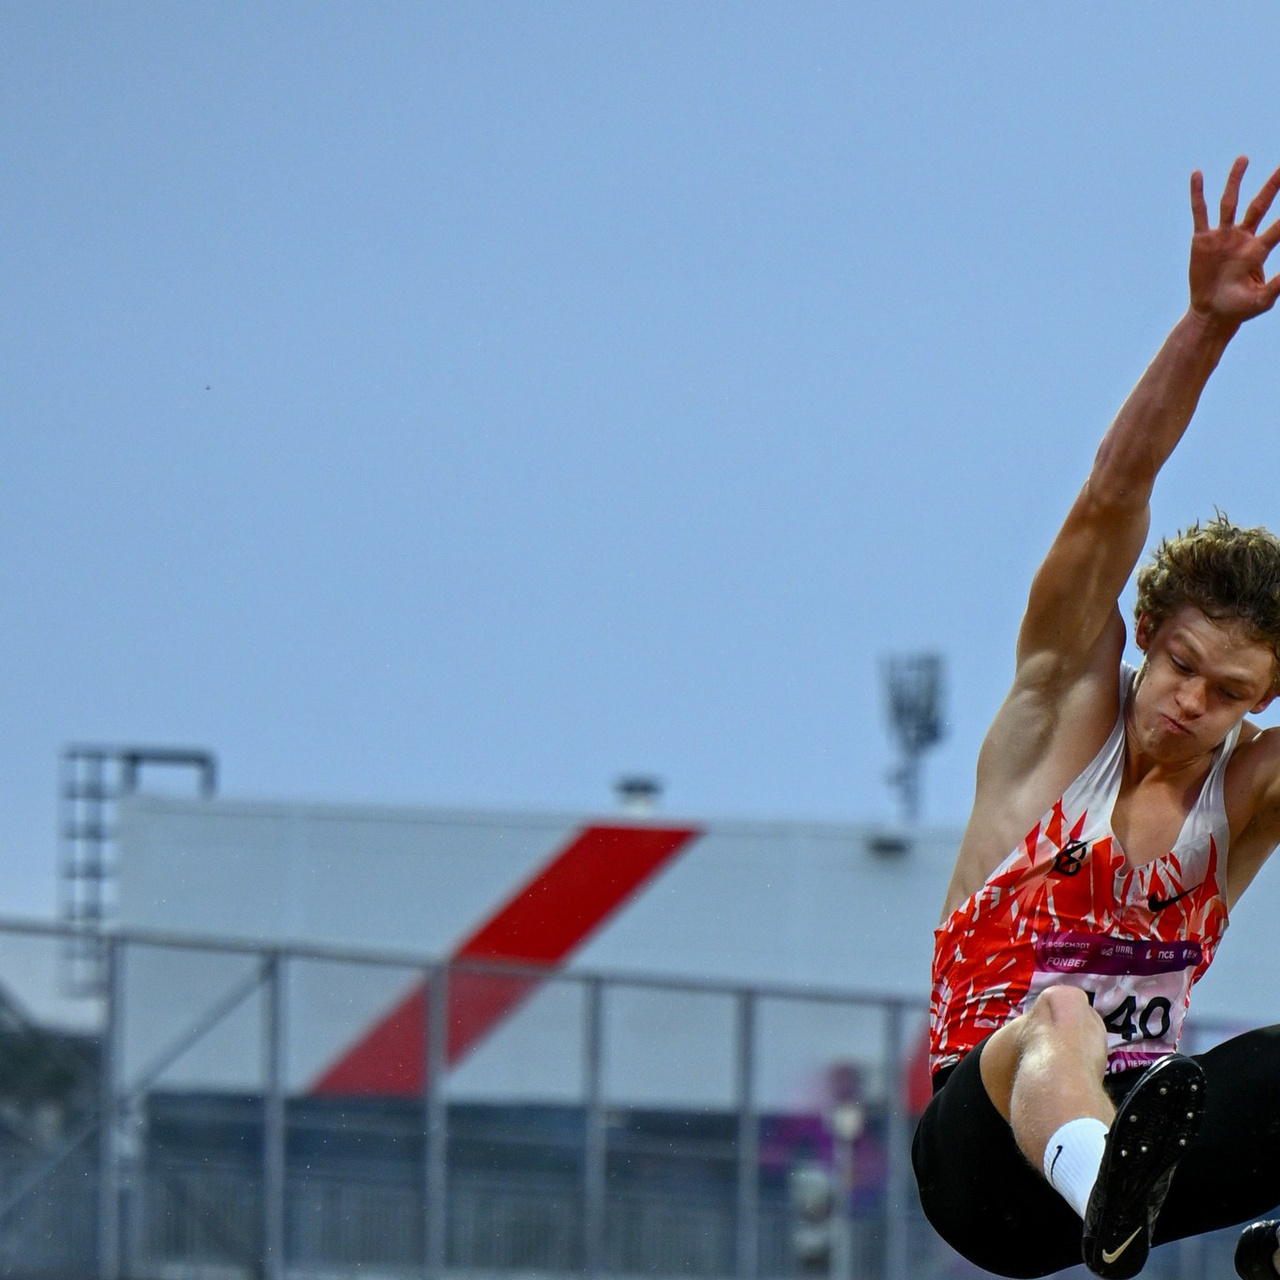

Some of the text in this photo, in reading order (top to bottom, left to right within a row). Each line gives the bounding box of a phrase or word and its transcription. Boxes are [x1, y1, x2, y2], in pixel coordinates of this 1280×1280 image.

[1158, 950, 1175, 960] ПСБ
[1045, 956, 1087, 968] FONBET
[1086, 991, 1171, 1041] 40
